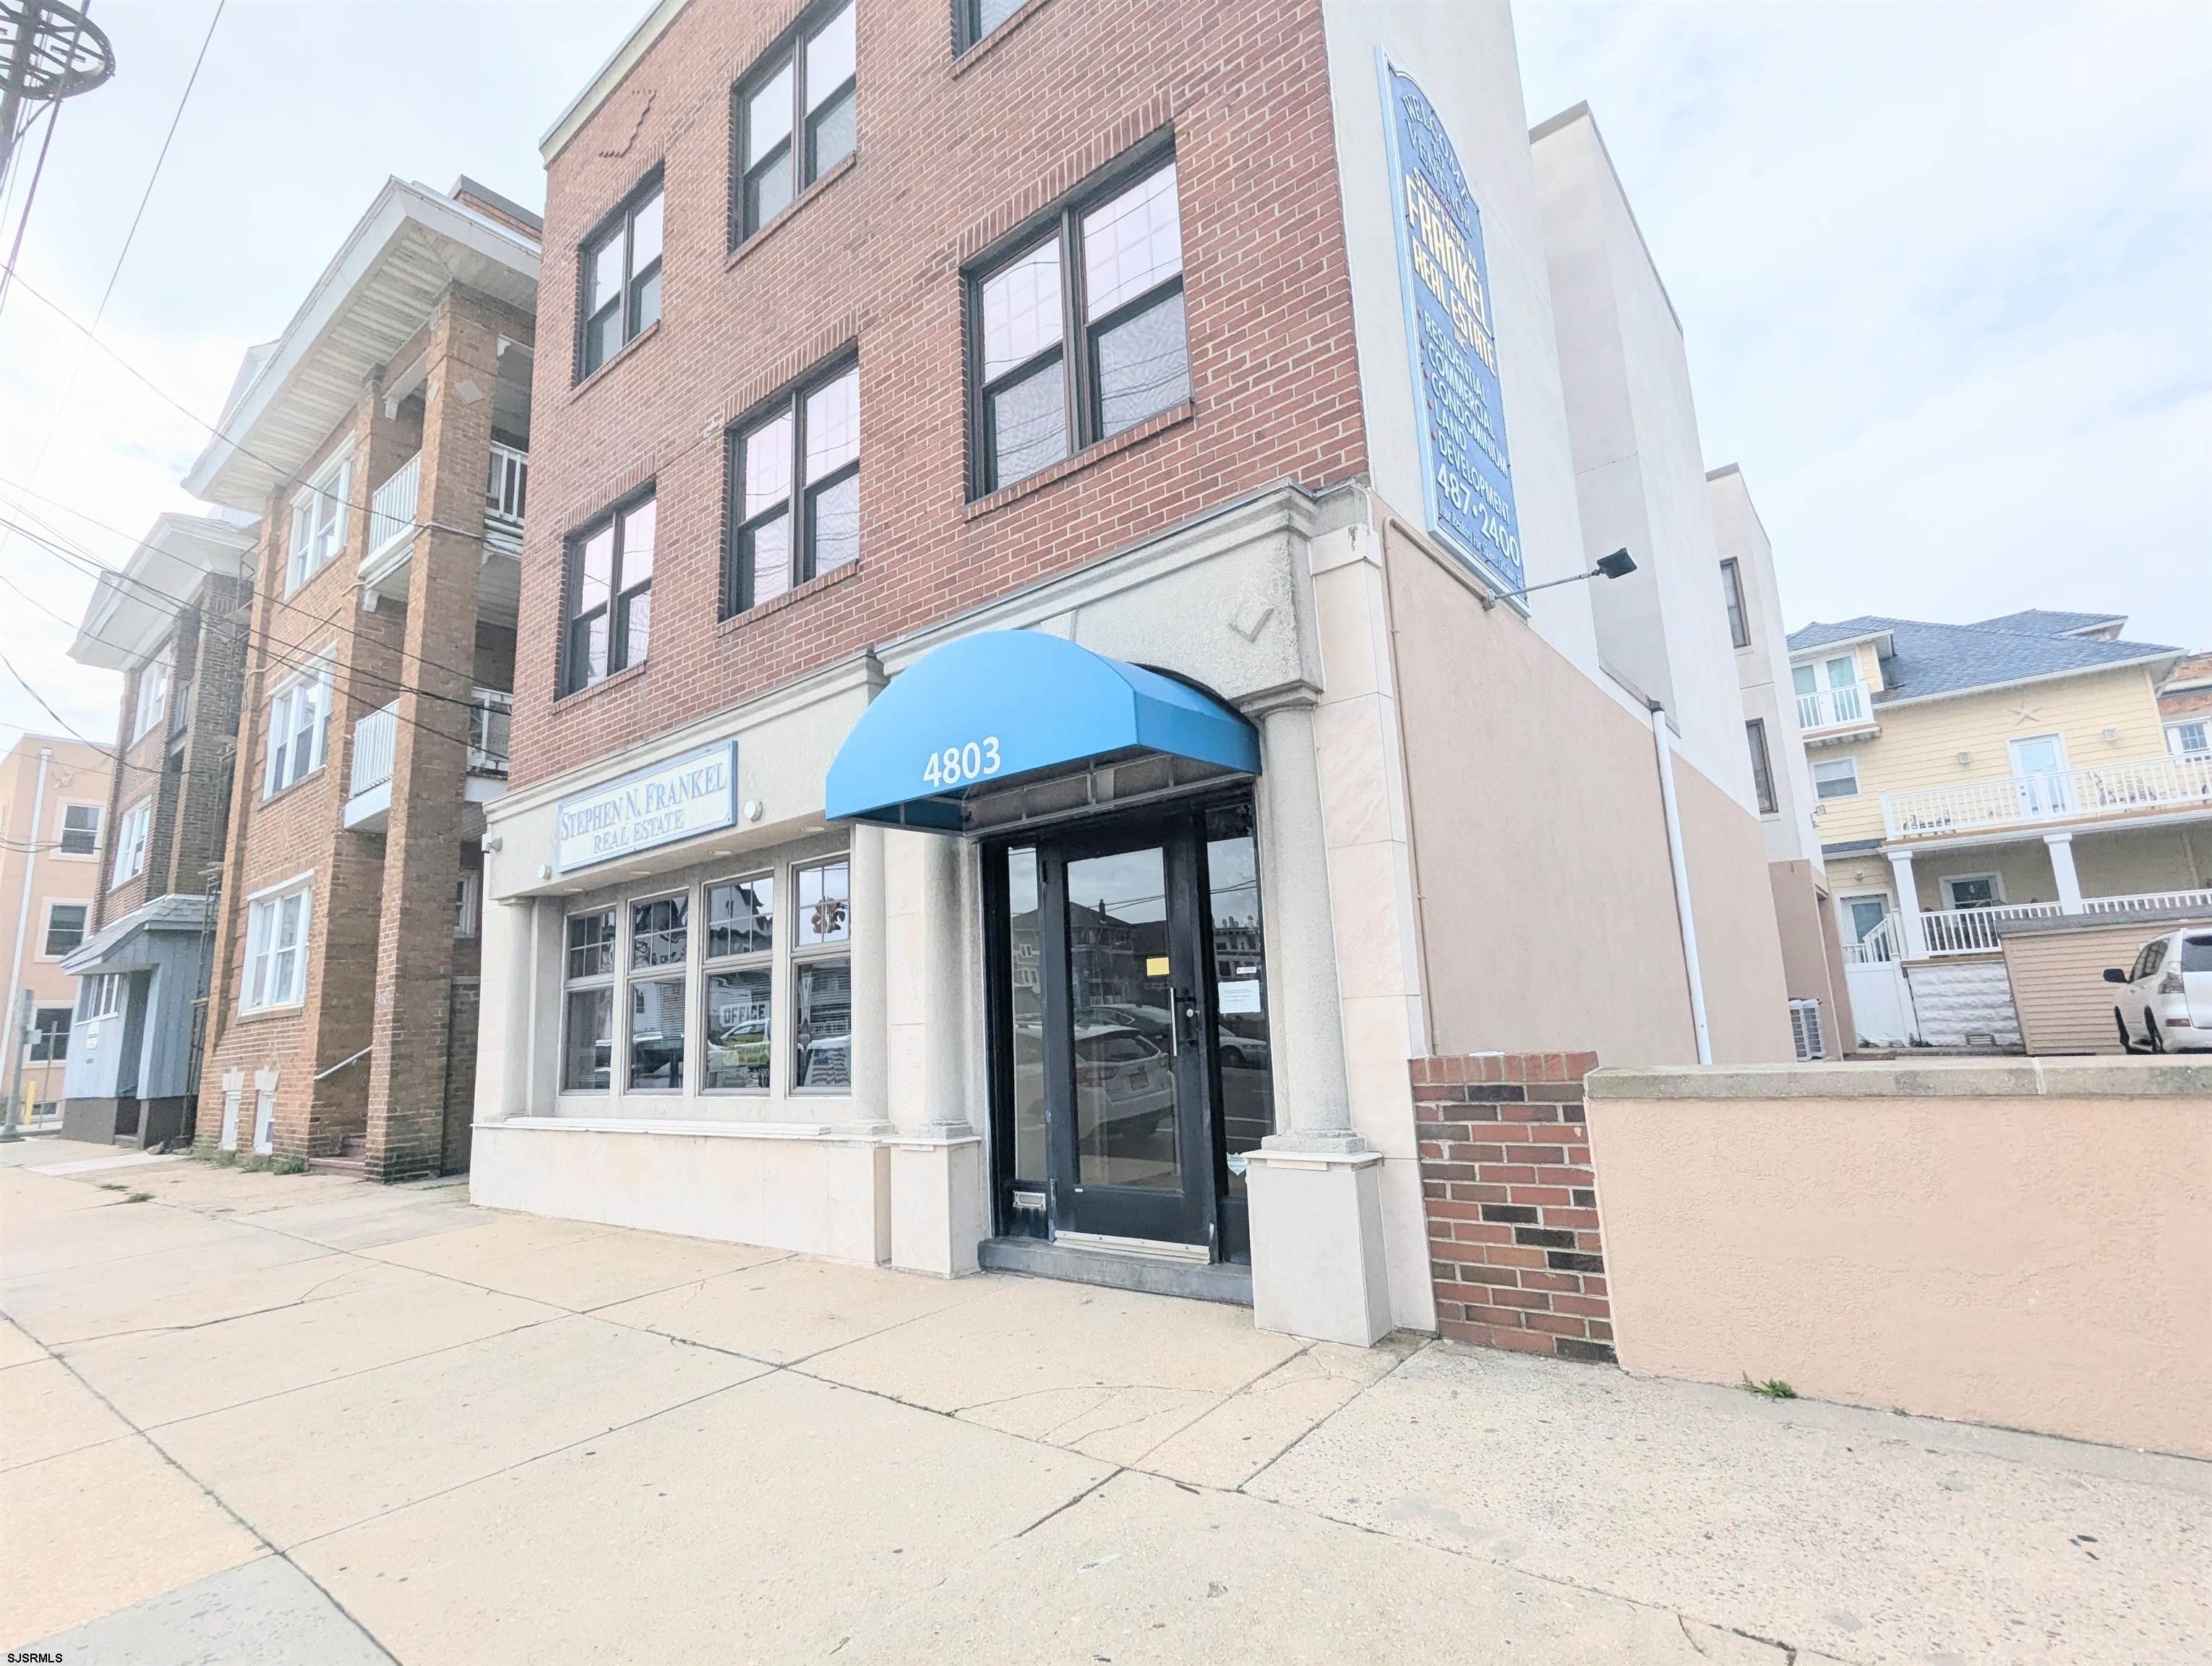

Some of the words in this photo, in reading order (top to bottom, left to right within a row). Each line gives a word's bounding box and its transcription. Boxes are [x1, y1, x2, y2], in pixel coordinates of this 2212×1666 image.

[1402, 94, 1469, 208] WELCOME
[1406, 119, 1473, 239] VENTNOR
[1431, 140, 1444, 169] TO
[1405, 174, 1492, 338] FRANKEL
[1413, 167, 1466, 255] STEPHEN
[1412, 235, 1449, 315] REAL
[1450, 289, 1496, 378] ESTATE
[1424, 309, 1487, 407] RESIDENTIAL
[1428, 342, 1495, 440] COMMERCIAL
[1431, 372, 1509, 477] CONDOMINIUM
[1433, 398, 1467, 451] LAND
[1437, 429, 1510, 524] DEVELOPMENT
[1438, 499, 1452, 523] Your
[561, 797, 624, 840] STEPHEN
[625, 788, 642, 821] N.
[644, 762, 728, 814] FRANKEL
[923, 735, 1000, 787] 4803
[593, 830, 630, 853] REAL
[634, 808, 685, 842] ESTATE
[724, 1004, 766, 1024] OFFICE
